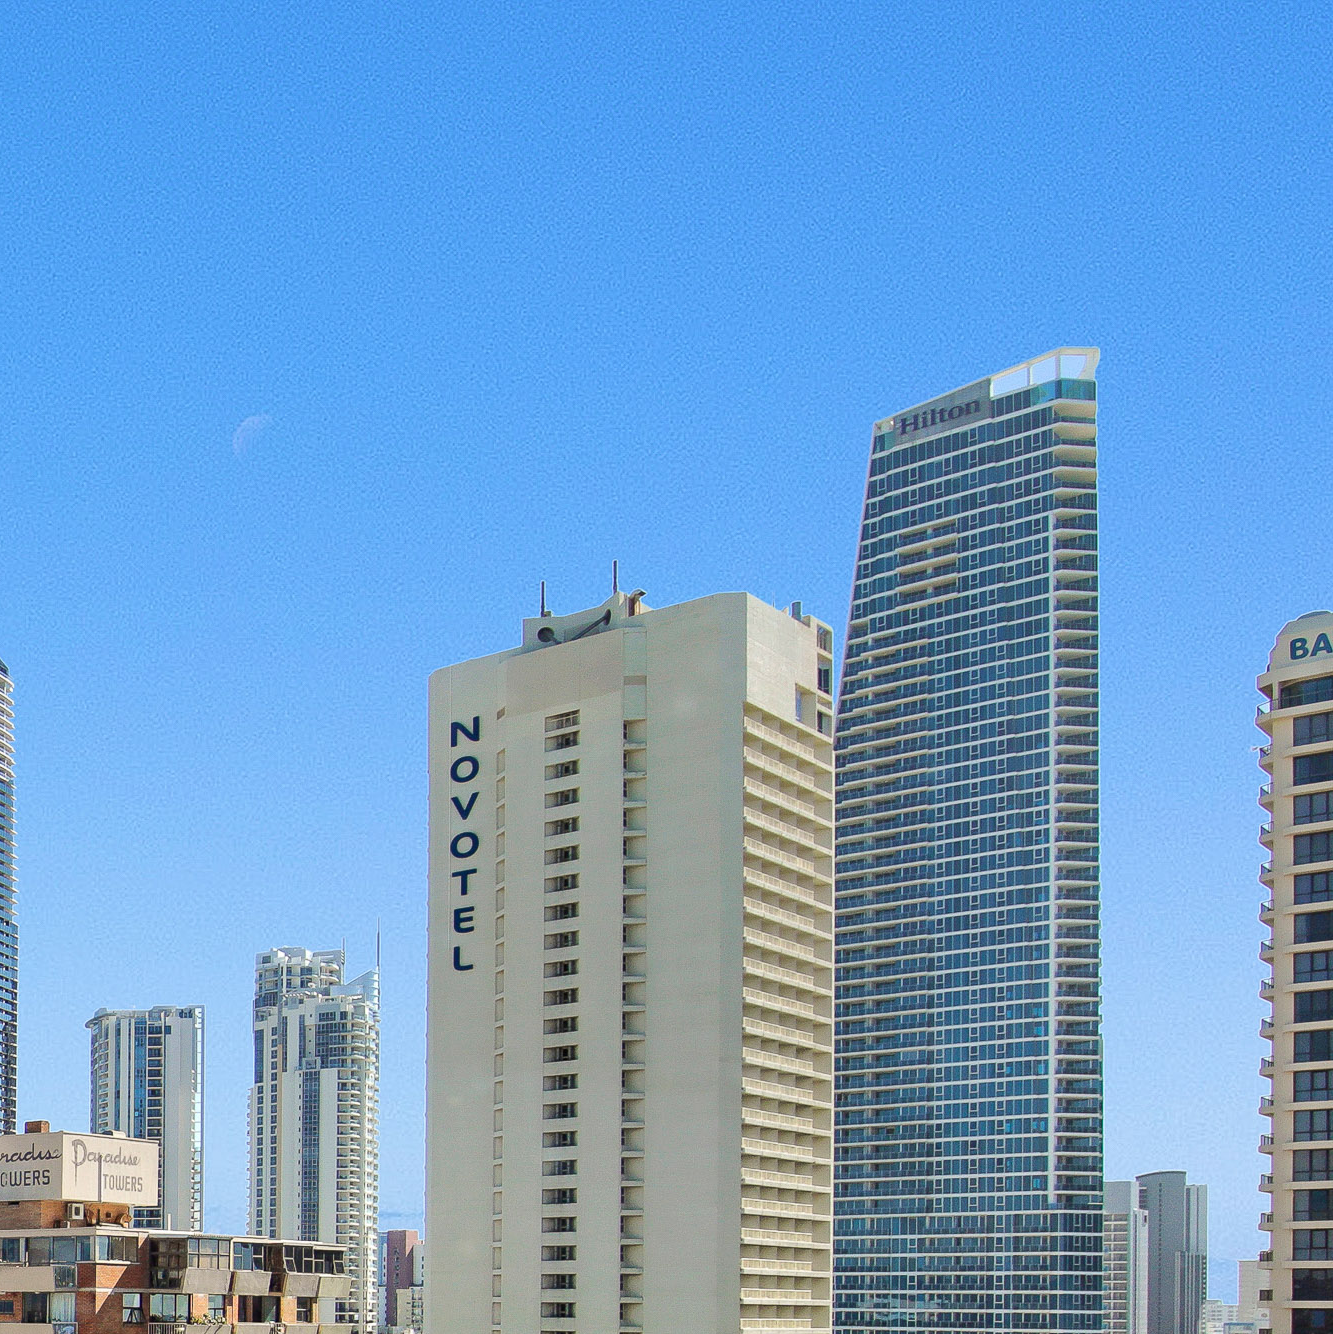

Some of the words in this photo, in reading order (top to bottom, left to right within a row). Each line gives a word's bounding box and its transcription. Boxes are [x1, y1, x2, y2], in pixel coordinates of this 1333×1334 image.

[900, 400, 980, 435] Hilton
[1289, 632, 1333, 660] BA
[450, 715, 480, 972] NOVOTEL
[71, 1138, 141, 1187] Paradise
[102, 1173, 143, 1193] TOWERS
